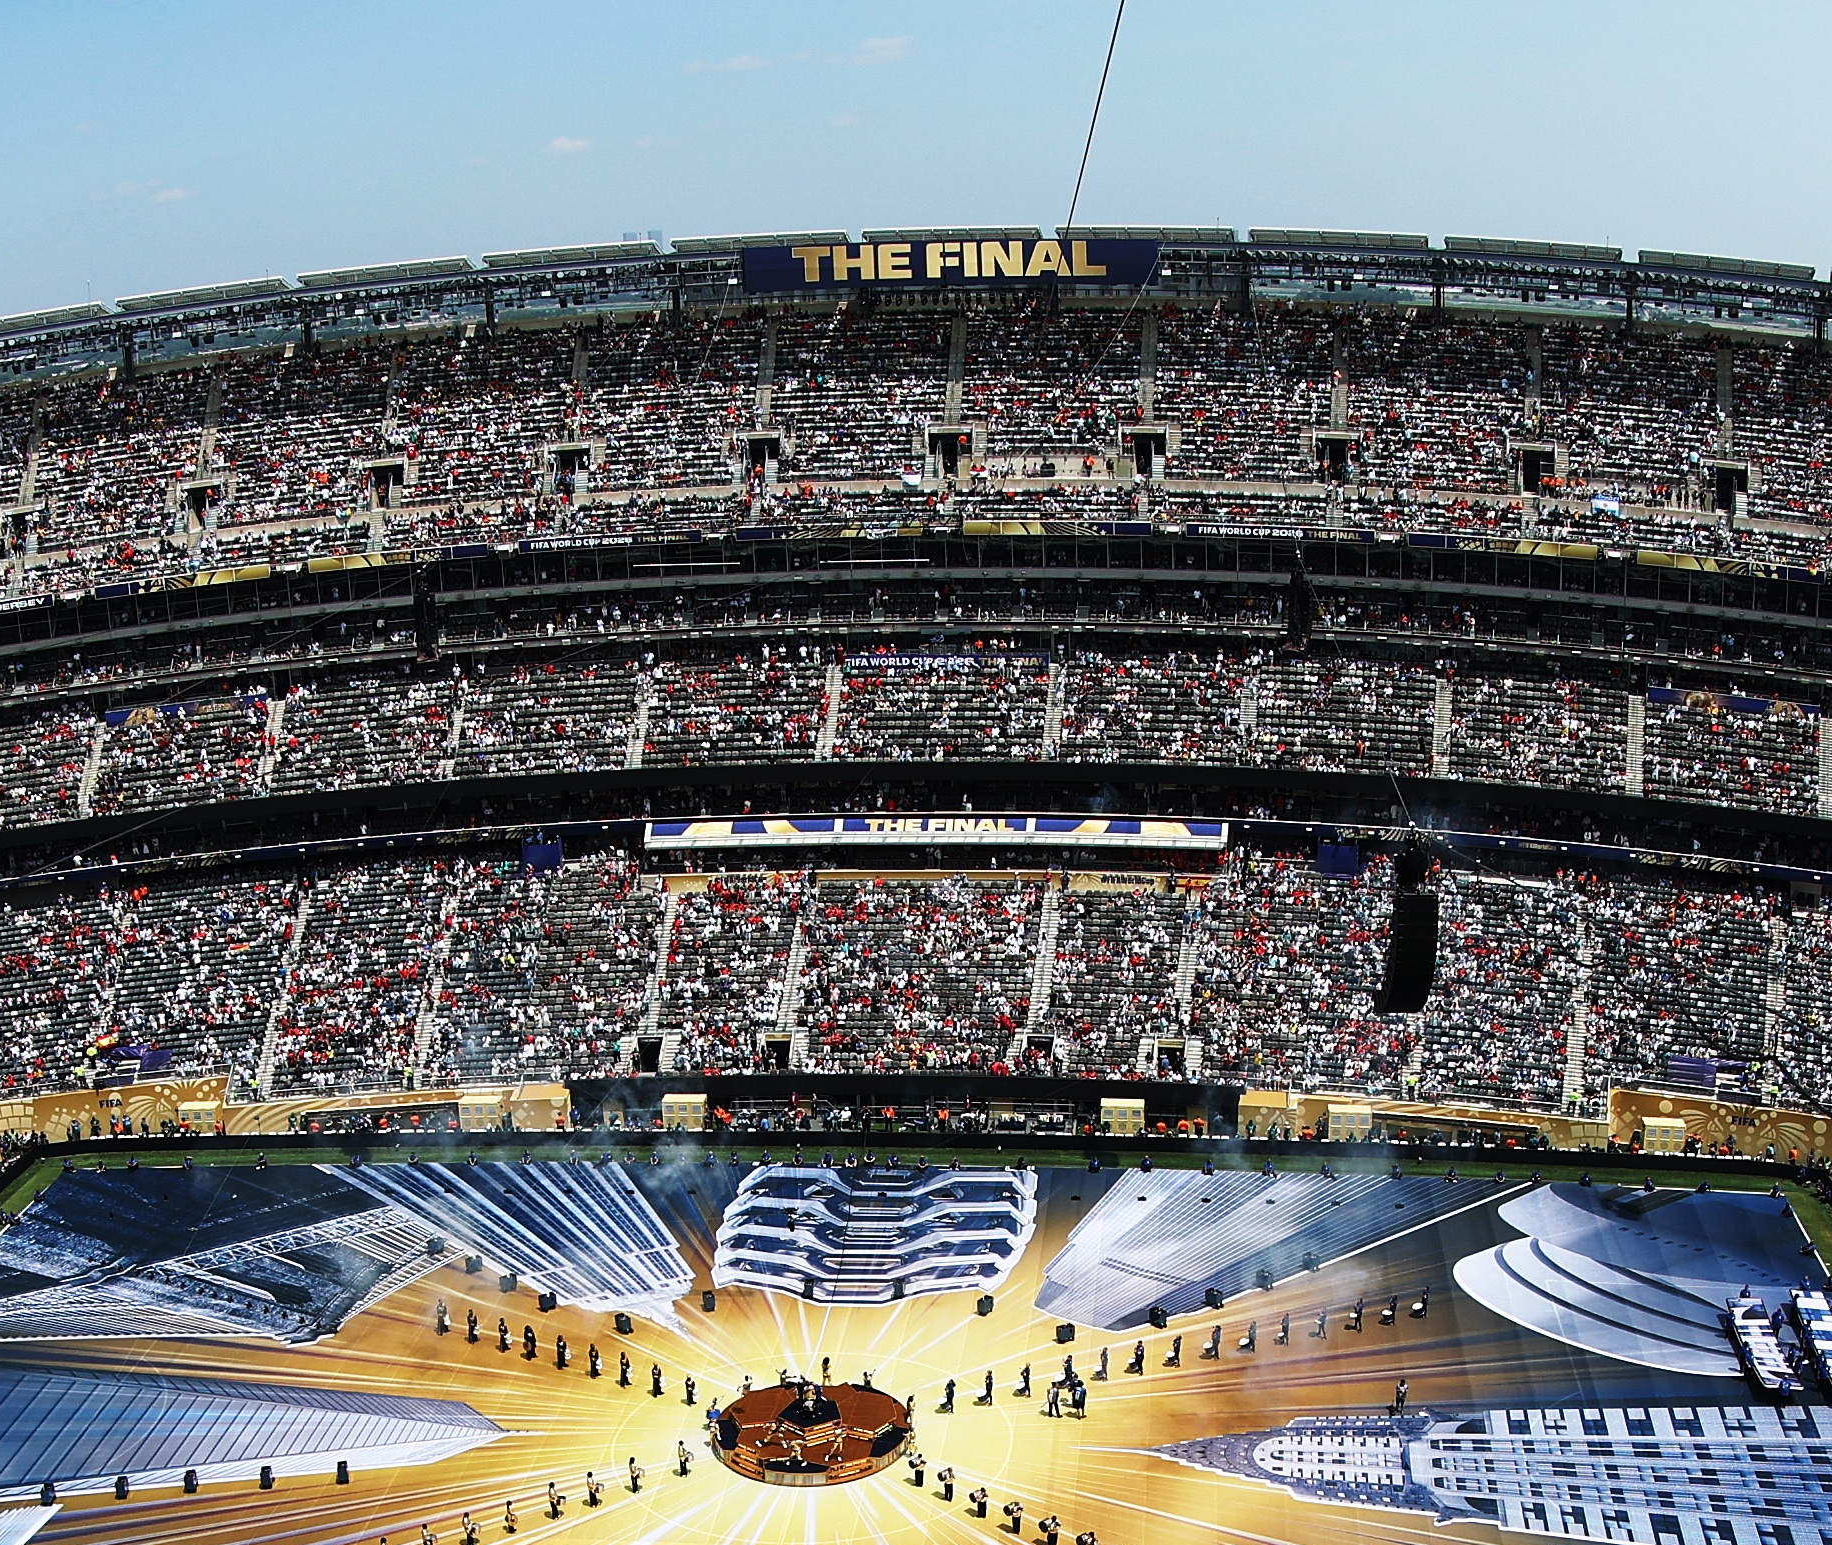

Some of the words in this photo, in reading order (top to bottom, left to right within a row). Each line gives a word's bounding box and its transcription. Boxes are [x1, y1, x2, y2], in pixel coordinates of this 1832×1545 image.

[792, 243, 913, 283] THE
[926, 240, 1107, 279] FINAL
[1198, 525, 1215, 534] FIFA
[1217, 526, 1248, 536] WORLD
[1249, 528, 1267, 537] CUP
[1307, 530, 1327, 539] THE
[1328, 531, 1362, 540] FINAL
[530, 541, 549, 550] FIFA
[550, 539, 583, 549] WORLD
[583, 538, 601, 547] CUP
[602, 536, 634, 546] 2026
[869, 656, 912, 667] WORLD
[865, 819, 913, 832] THE
[915, 818, 1017, 833] FINAL
[98, 1098, 123, 1109] FIFA
[1731, 1115, 1757, 1128] FIFA
